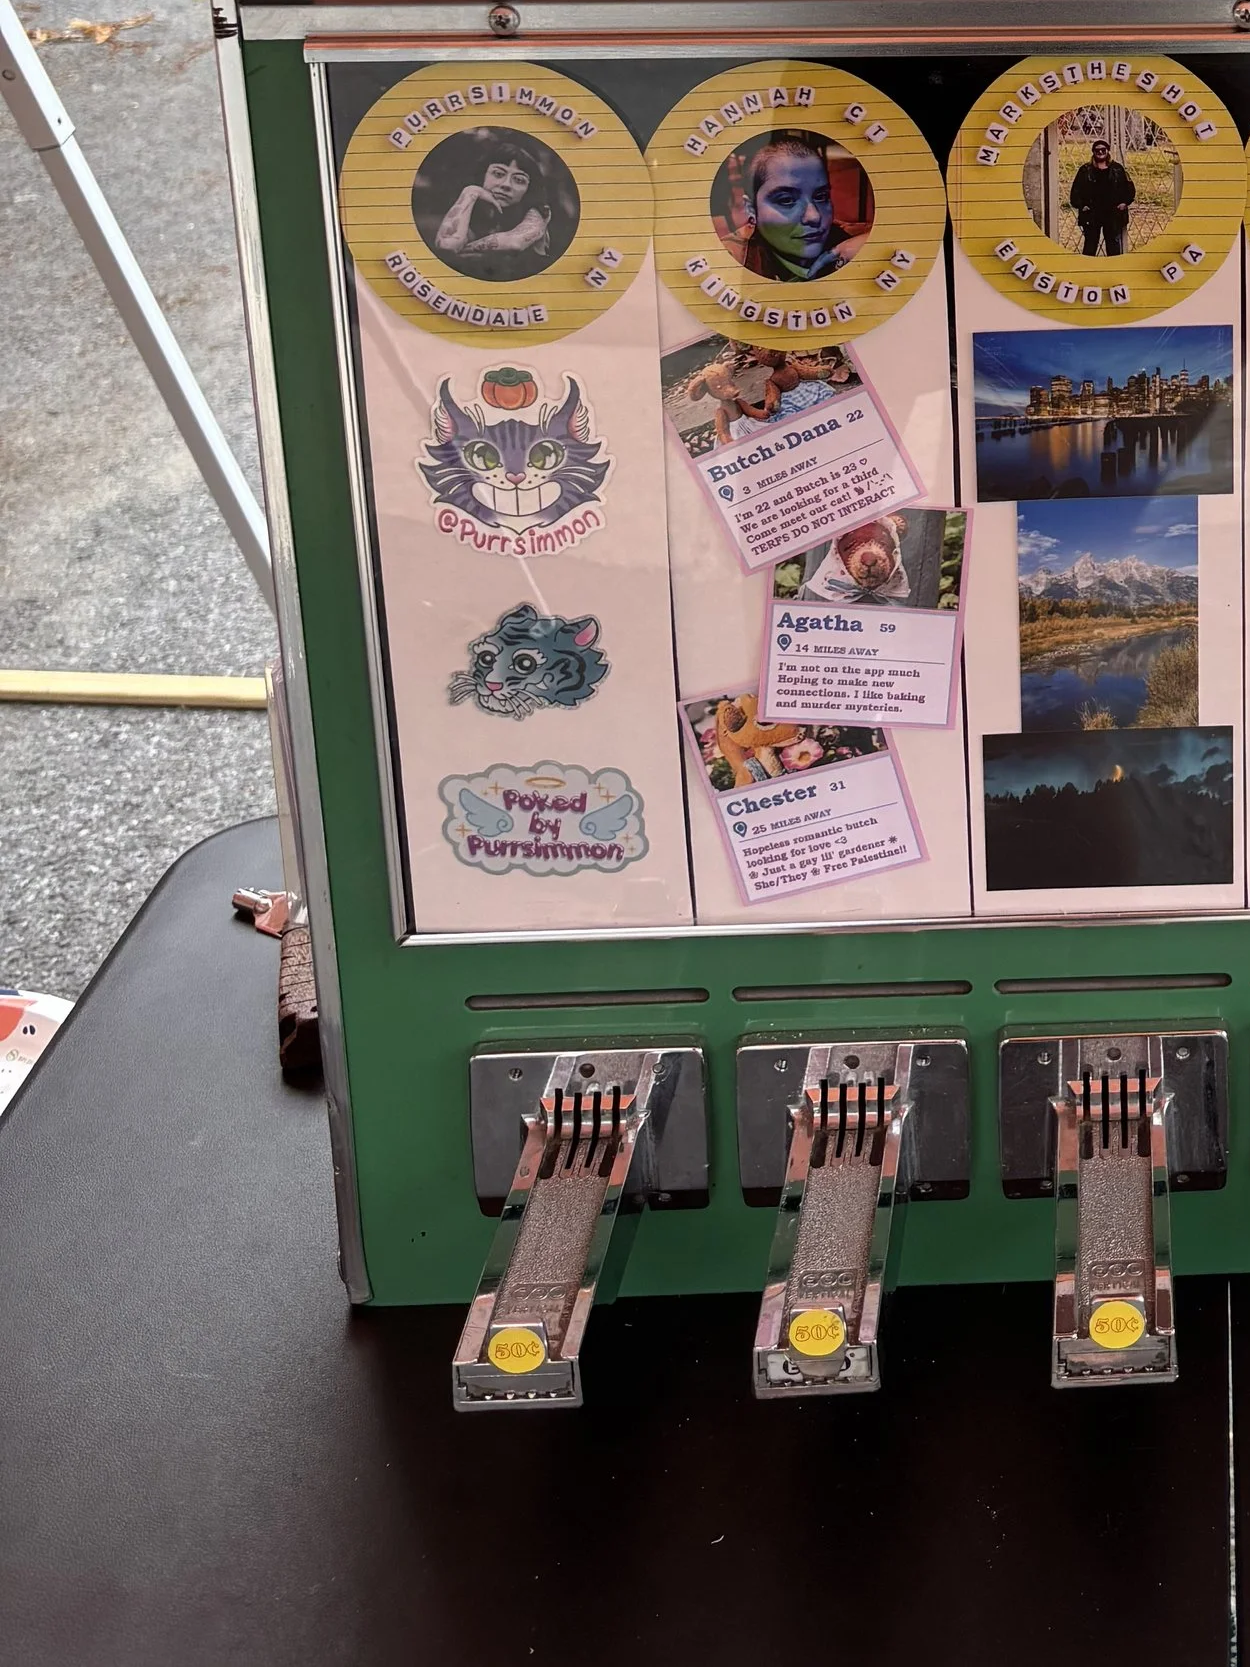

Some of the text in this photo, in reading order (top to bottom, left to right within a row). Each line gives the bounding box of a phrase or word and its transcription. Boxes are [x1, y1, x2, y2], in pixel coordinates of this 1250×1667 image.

[393, 85, 595, 145] PURRSIMMON
[686, 86, 885, 153] HANNAH CT
[981, 62, 1214, 163] MARKSTHESHOT
[387, 251, 620, 324] ROSENDALE NY
[687, 253, 911, 328] KINGSTON NY
[999, 242, 1202, 302] EASTON PA
[707, 409, 864, 483] Butch & Dana 22
[734, 463, 857, 523] I'm 22 and Butch is 23
[742, 457, 818, 495] 3 MILES AWAY
[740, 522, 758, 535] We
[760, 516, 778, 526] are
[780, 497, 821, 519] looking
[823, 486, 840, 500] for
[851, 468, 879, 486] third
[746, 492, 852, 544] Come meet our cat!
[751, 486, 896, 556] TERFS DO NOT INTERACT
[777, 612, 896, 633] Agatha 59
[795, 644, 879, 657] 14 MILES AWAY
[778, 662, 920, 679] I'm not on the app much
[778, 675, 895, 688] Hoping to make new
[776, 699, 903, 714] and murder mysteries.
[777, 687, 926, 704] connections. I like baking
[503, 788, 587, 816] Poked
[726, 781, 846, 817] Chester 31
[529, 812, 562, 837] by
[742, 817, 878, 857] Hopeless romantic butch
[752, 809, 832, 834] 25 MILES AWAY
[468, 834, 625, 862] Purrsimmon
[747, 836, 848, 869] looking for love <3
[762, 863, 786, 877] Just
[798, 856, 819, 870] gay
[837, 838, 886, 861] gardener
[754, 845, 907, 891] She/They Free Palestine!!
[795, 1324, 839, 1342] 50¢
[1095, 1317, 1139, 1334] 50¢
[495, 1341, 540, 1359] 50¢
